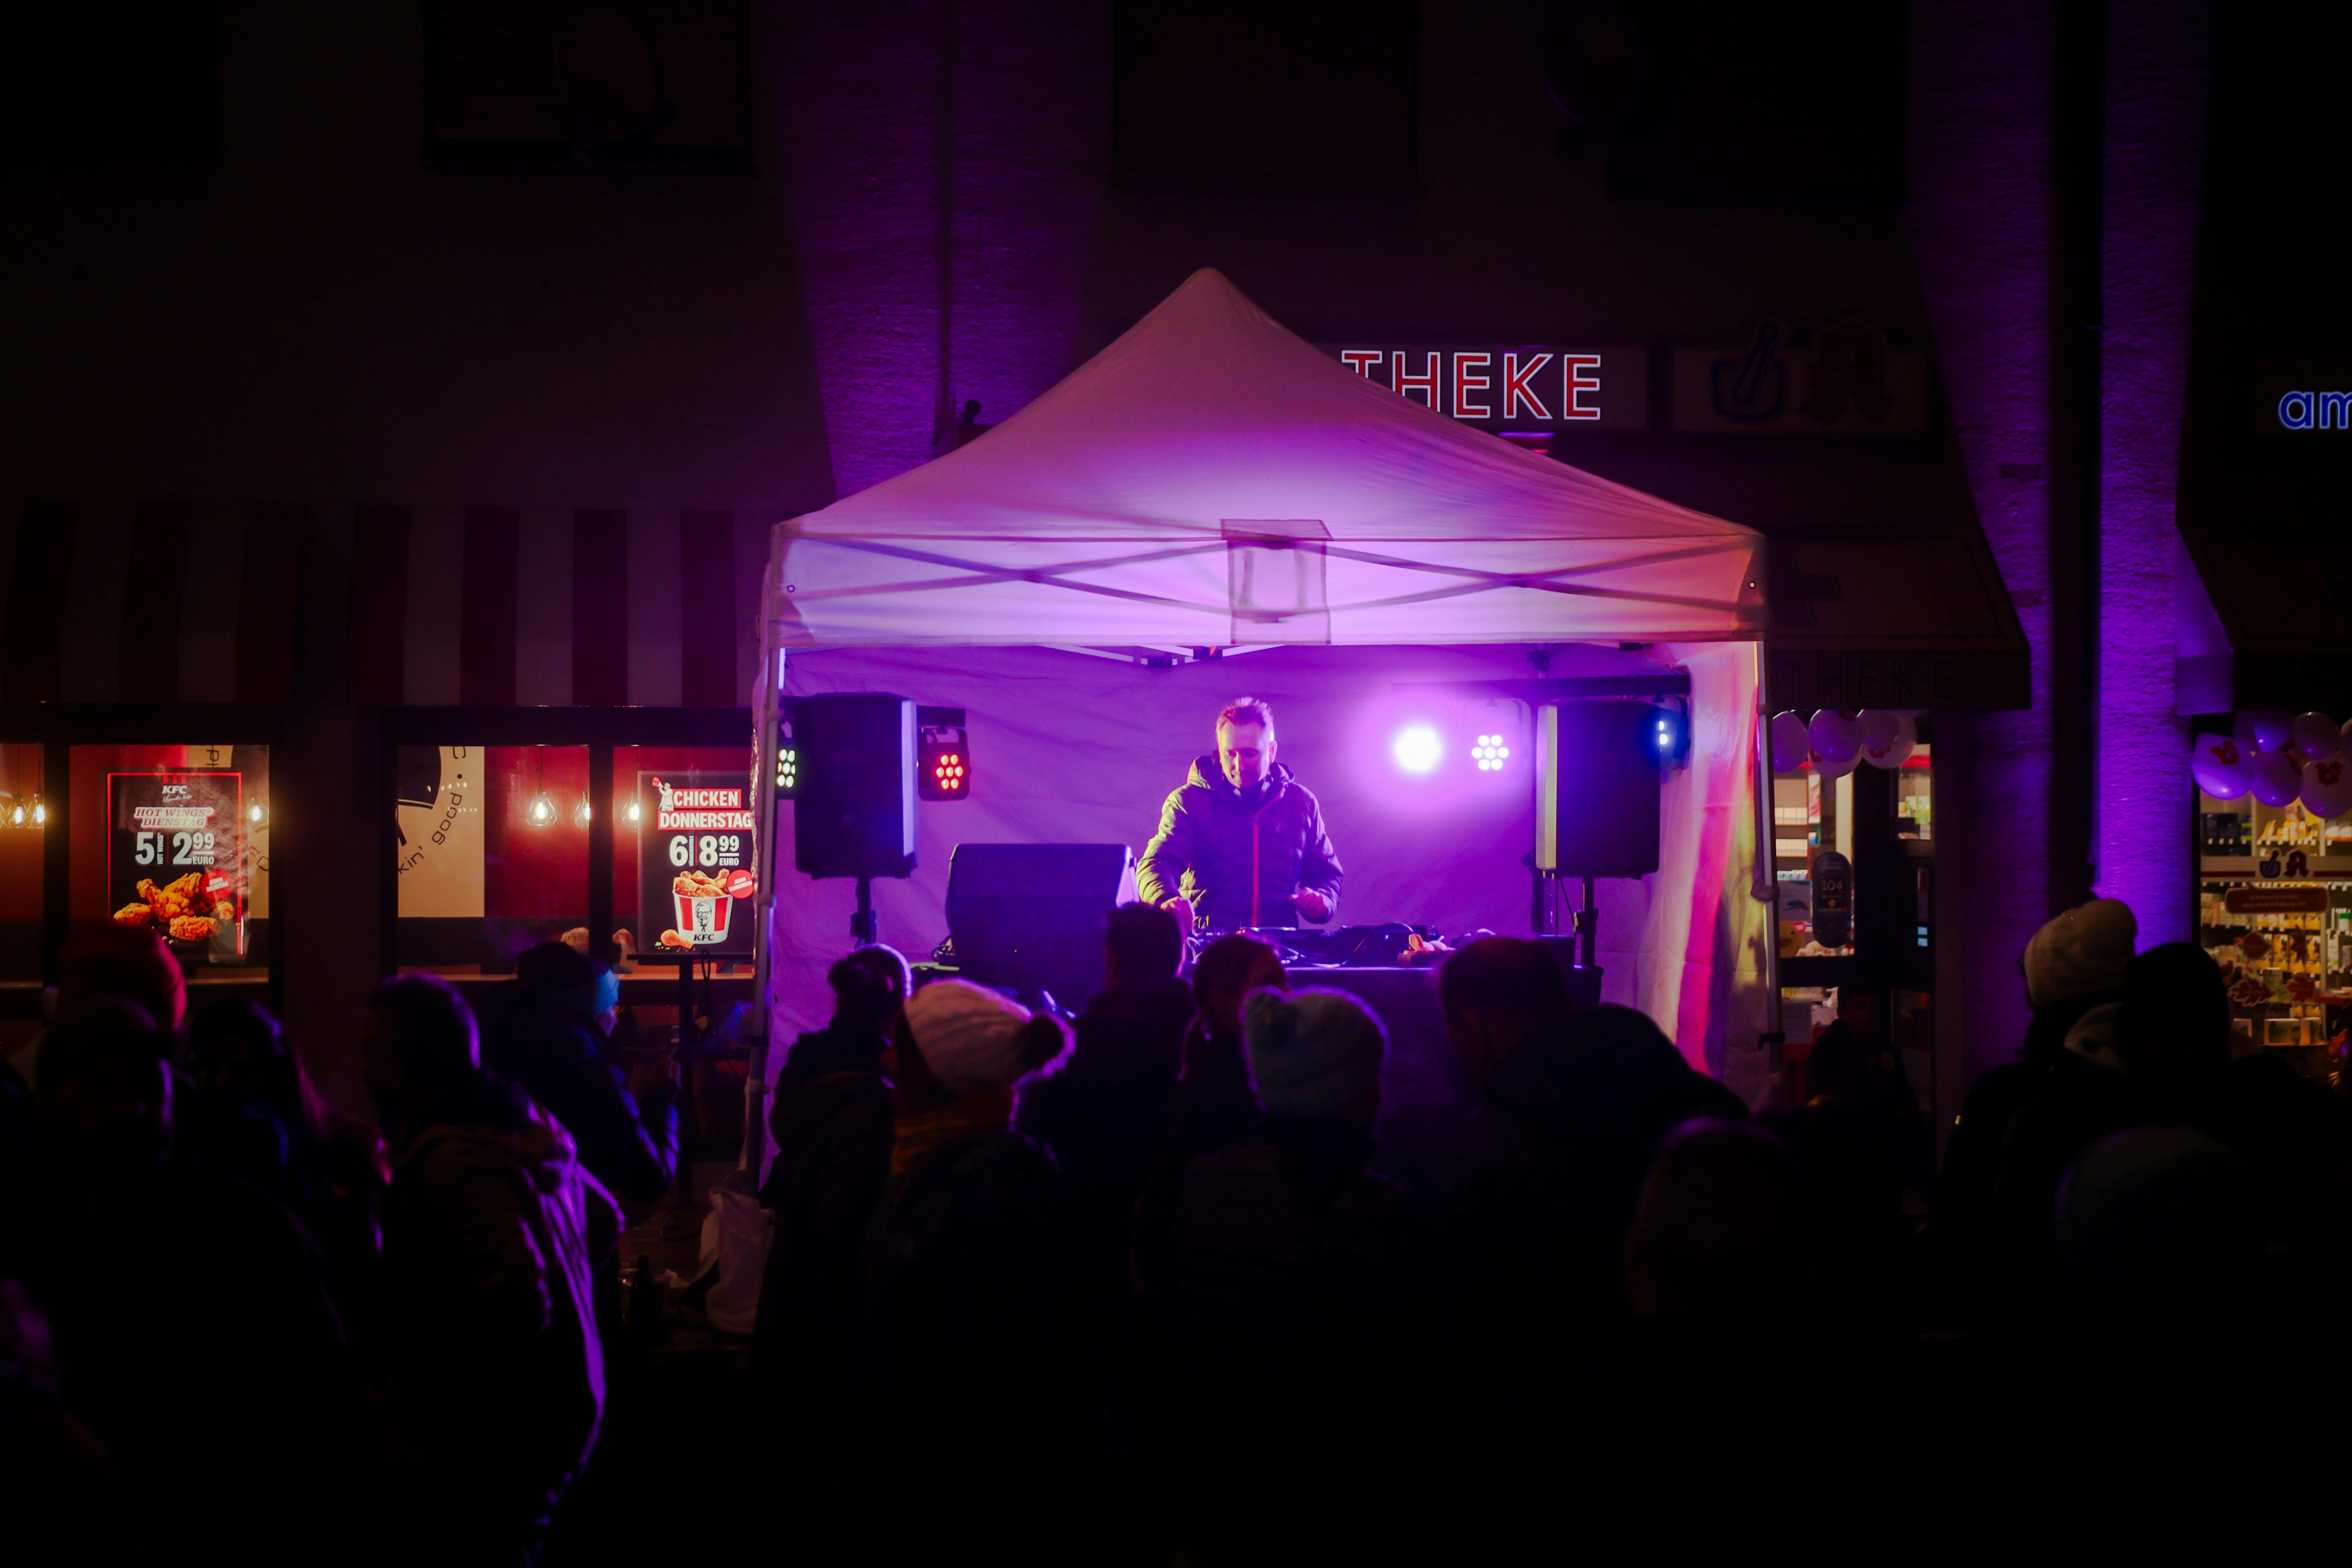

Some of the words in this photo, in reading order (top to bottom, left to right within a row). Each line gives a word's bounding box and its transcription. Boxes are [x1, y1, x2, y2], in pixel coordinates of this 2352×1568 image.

[1341, 350, 1601, 421] THEKE
[162, 785, 187, 794] KFC
[673, 790, 739, 806] CHICKEN
[143, 818, 205, 826] DIENSTAG
[432, 792, 462, 845] good
[660, 812, 752, 828] DONNERSTAG
[135, 832, 155, 865] 5
[669, 835, 688, 867] 6
[193, 856, 215, 865] EURO
[719, 858, 740, 866] EURO
[1821, 880, 1843, 890] 104
